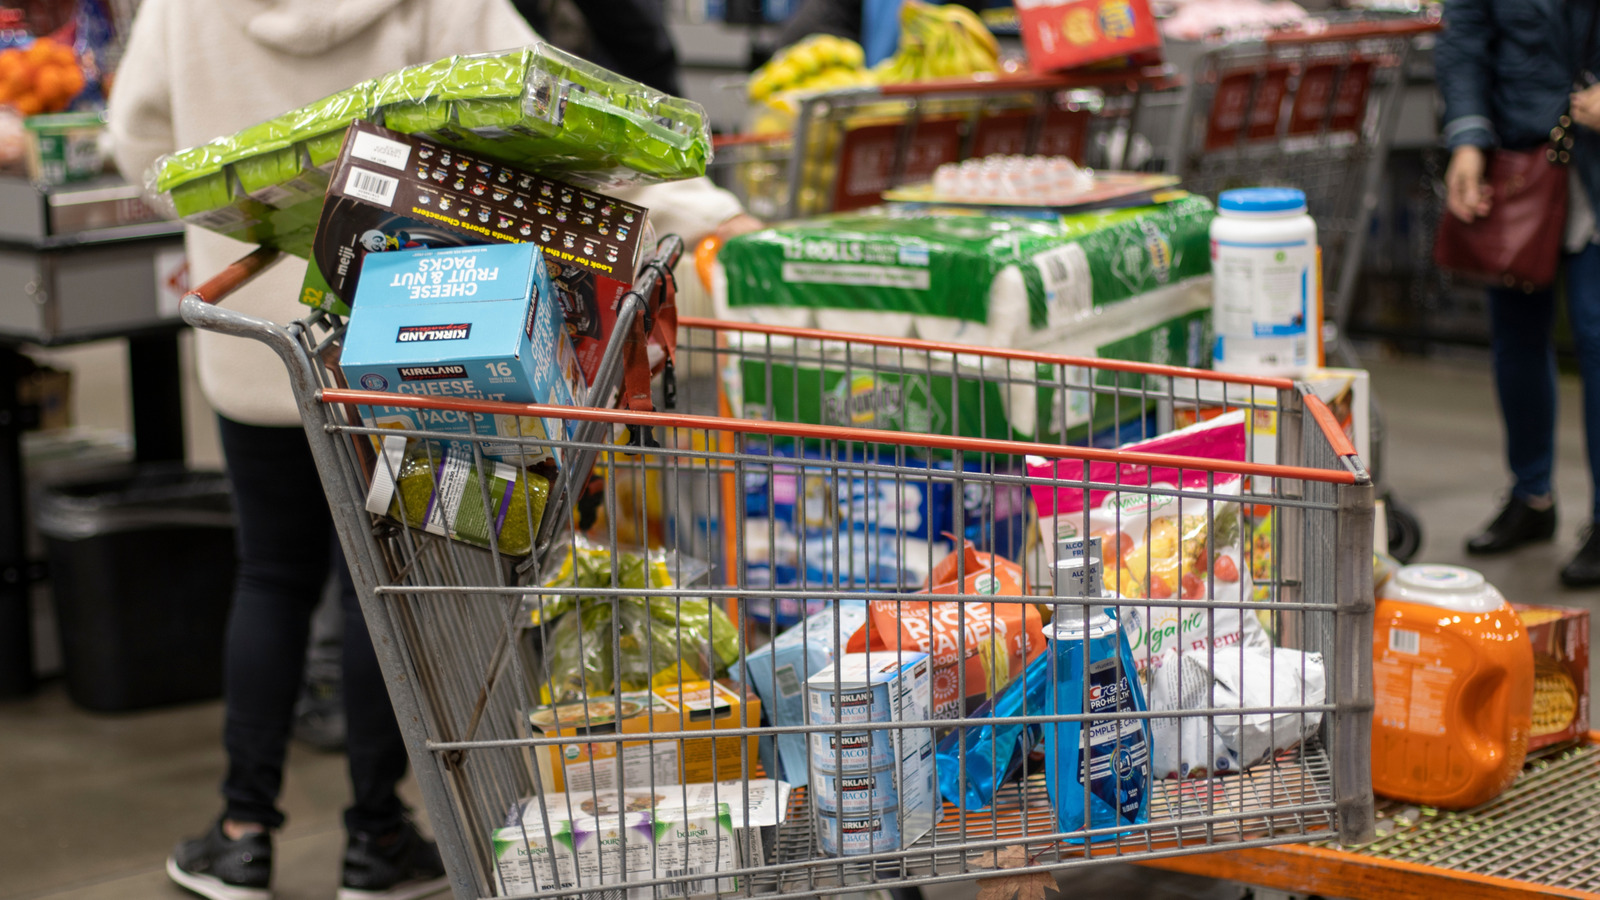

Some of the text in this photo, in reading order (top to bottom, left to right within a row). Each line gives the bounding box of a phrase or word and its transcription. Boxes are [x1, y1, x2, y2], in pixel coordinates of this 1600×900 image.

[410, 206, 460, 226] Characters
[460, 220, 491, 236] Sports
[490, 230, 519, 244] Panda
[338, 245, 356, 277] meiji
[419, 255, 477, 271] PACKS
[544, 246, 613, 273] Look for All the
[390, 267, 499, 287] FRUIT & NUT
[303, 287, 324, 306] 32
[407, 282, 478, 299] CHEESE,
[399, 329, 467, 341] KIRKLAND
[401, 366, 464, 376] KIRKLAND
[485, 362, 512, 377] 16
[415, 410, 485, 425] PACKS
[1065, 540, 1097, 550] ALCOOL
[901, 601, 992, 640] RICE
[917, 617, 1007, 655] RAMEN
[1014, 631, 1031, 649] 12
[933, 648, 973, 667] OODLS
